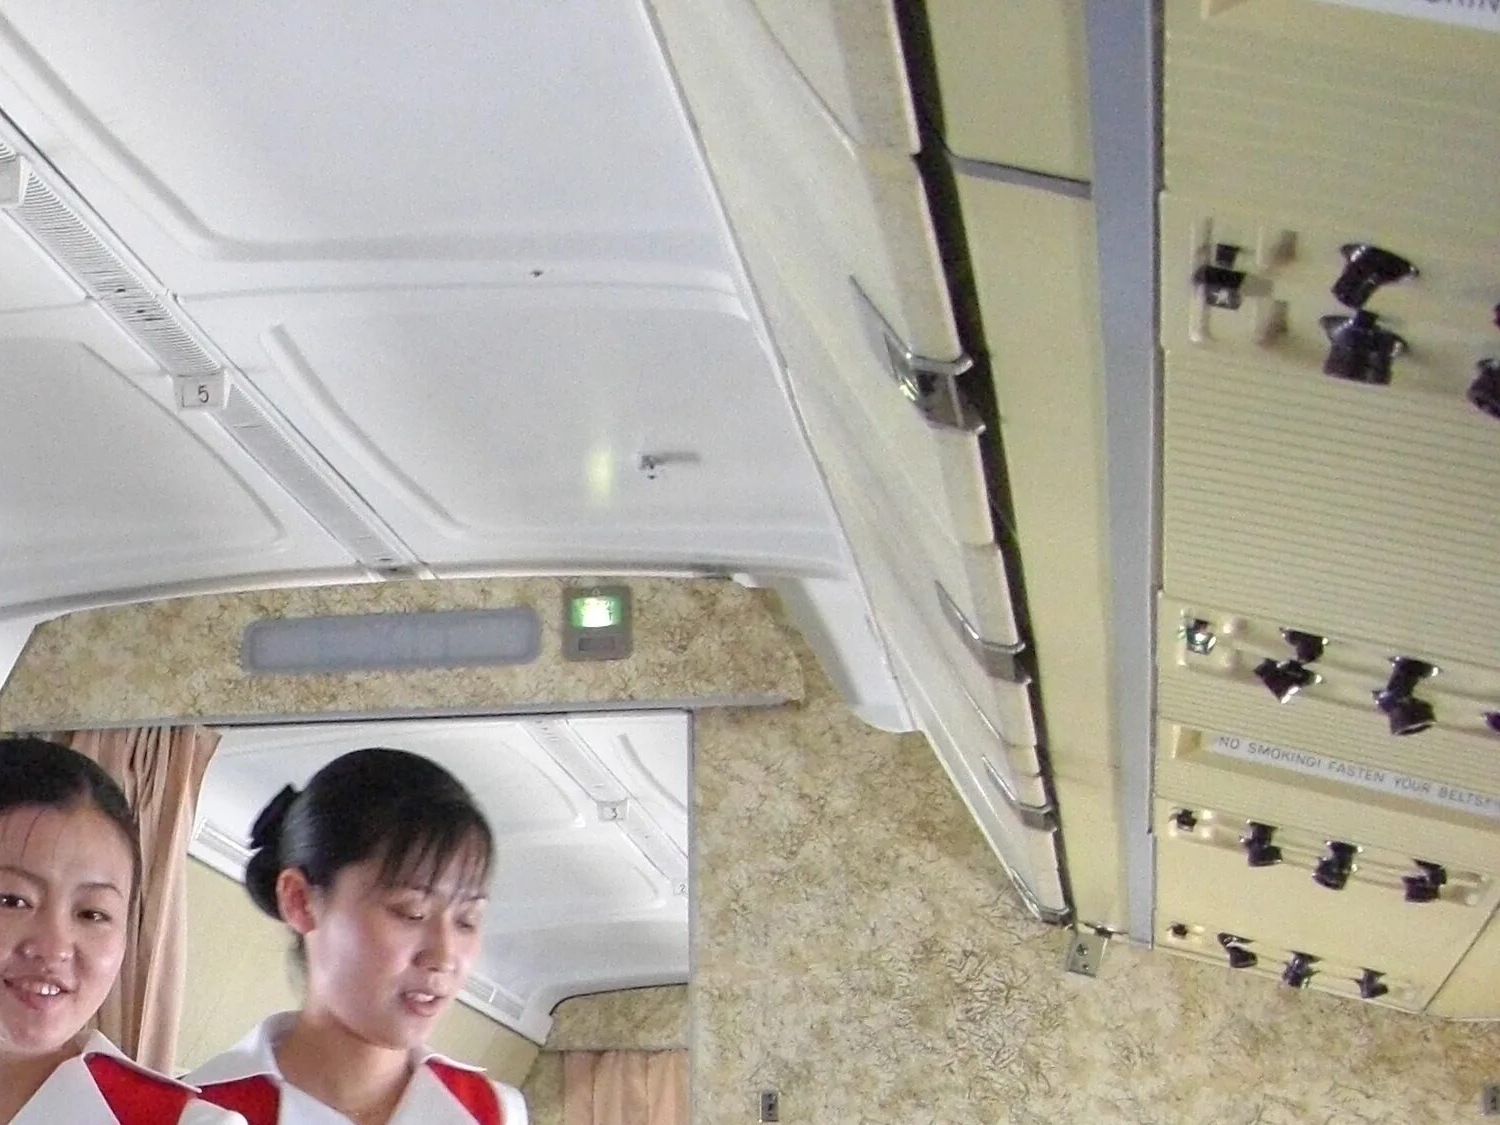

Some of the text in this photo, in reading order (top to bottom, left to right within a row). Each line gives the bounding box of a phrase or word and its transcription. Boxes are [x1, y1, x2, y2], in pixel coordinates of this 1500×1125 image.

[198, 384, 209, 404] 5
[1219, 736, 1240, 750] NO
[1247, 742, 1322, 768] SMOKING!
[1328, 761, 1385, 783] FASTEN
[1394, 777, 1430, 793] YOUR
